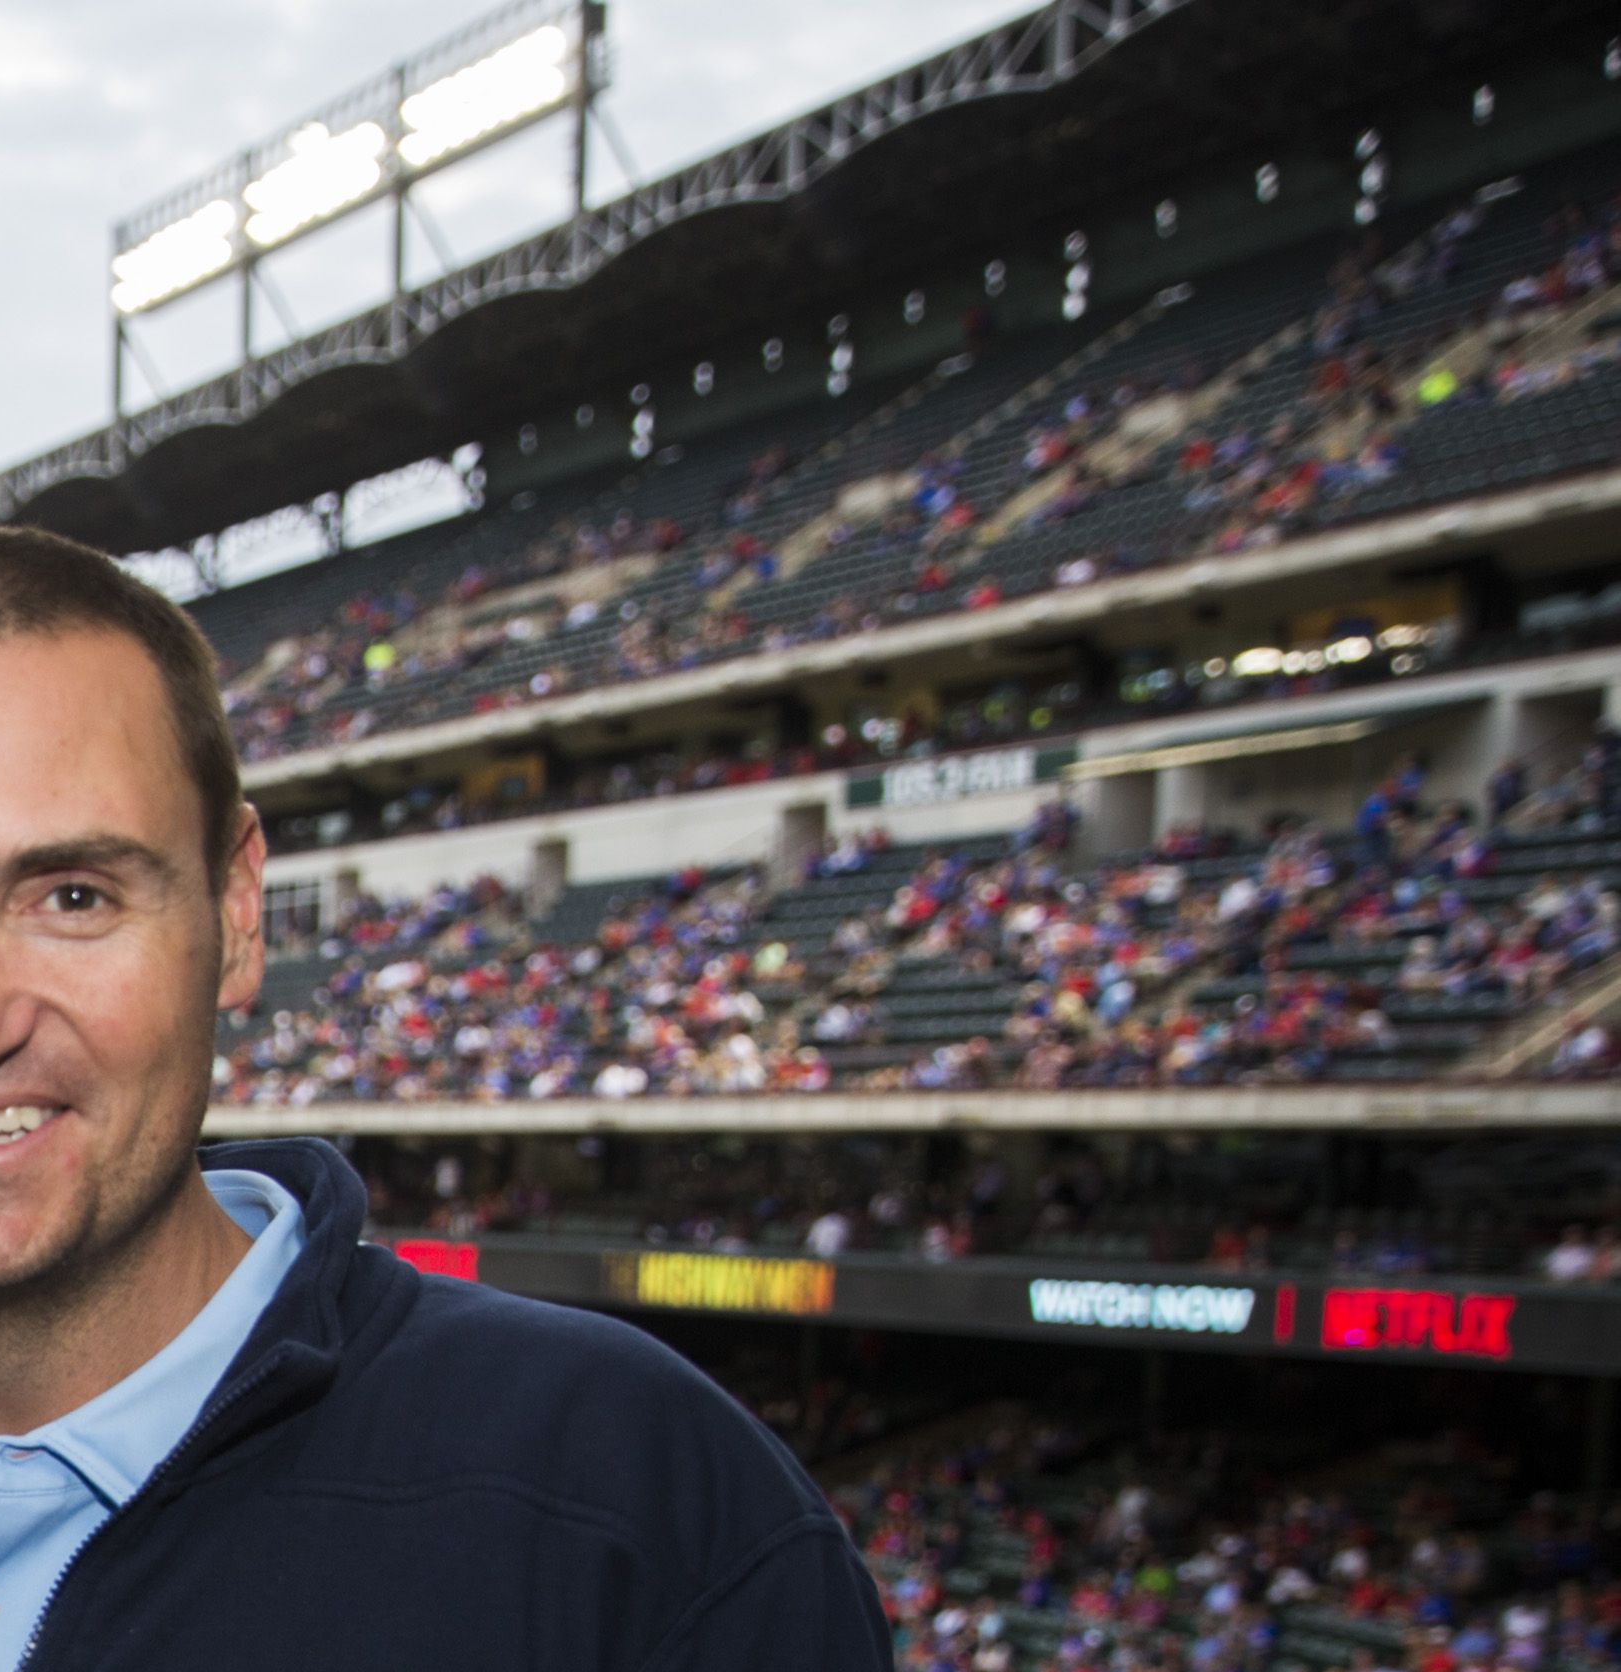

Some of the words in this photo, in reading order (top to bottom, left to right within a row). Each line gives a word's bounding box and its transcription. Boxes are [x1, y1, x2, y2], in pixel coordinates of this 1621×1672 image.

[1029, 1278, 1153, 1328] WATCH
[1154, 1284, 1255, 1334] NOW
[1322, 1287, 1515, 1361] NETFLIX
